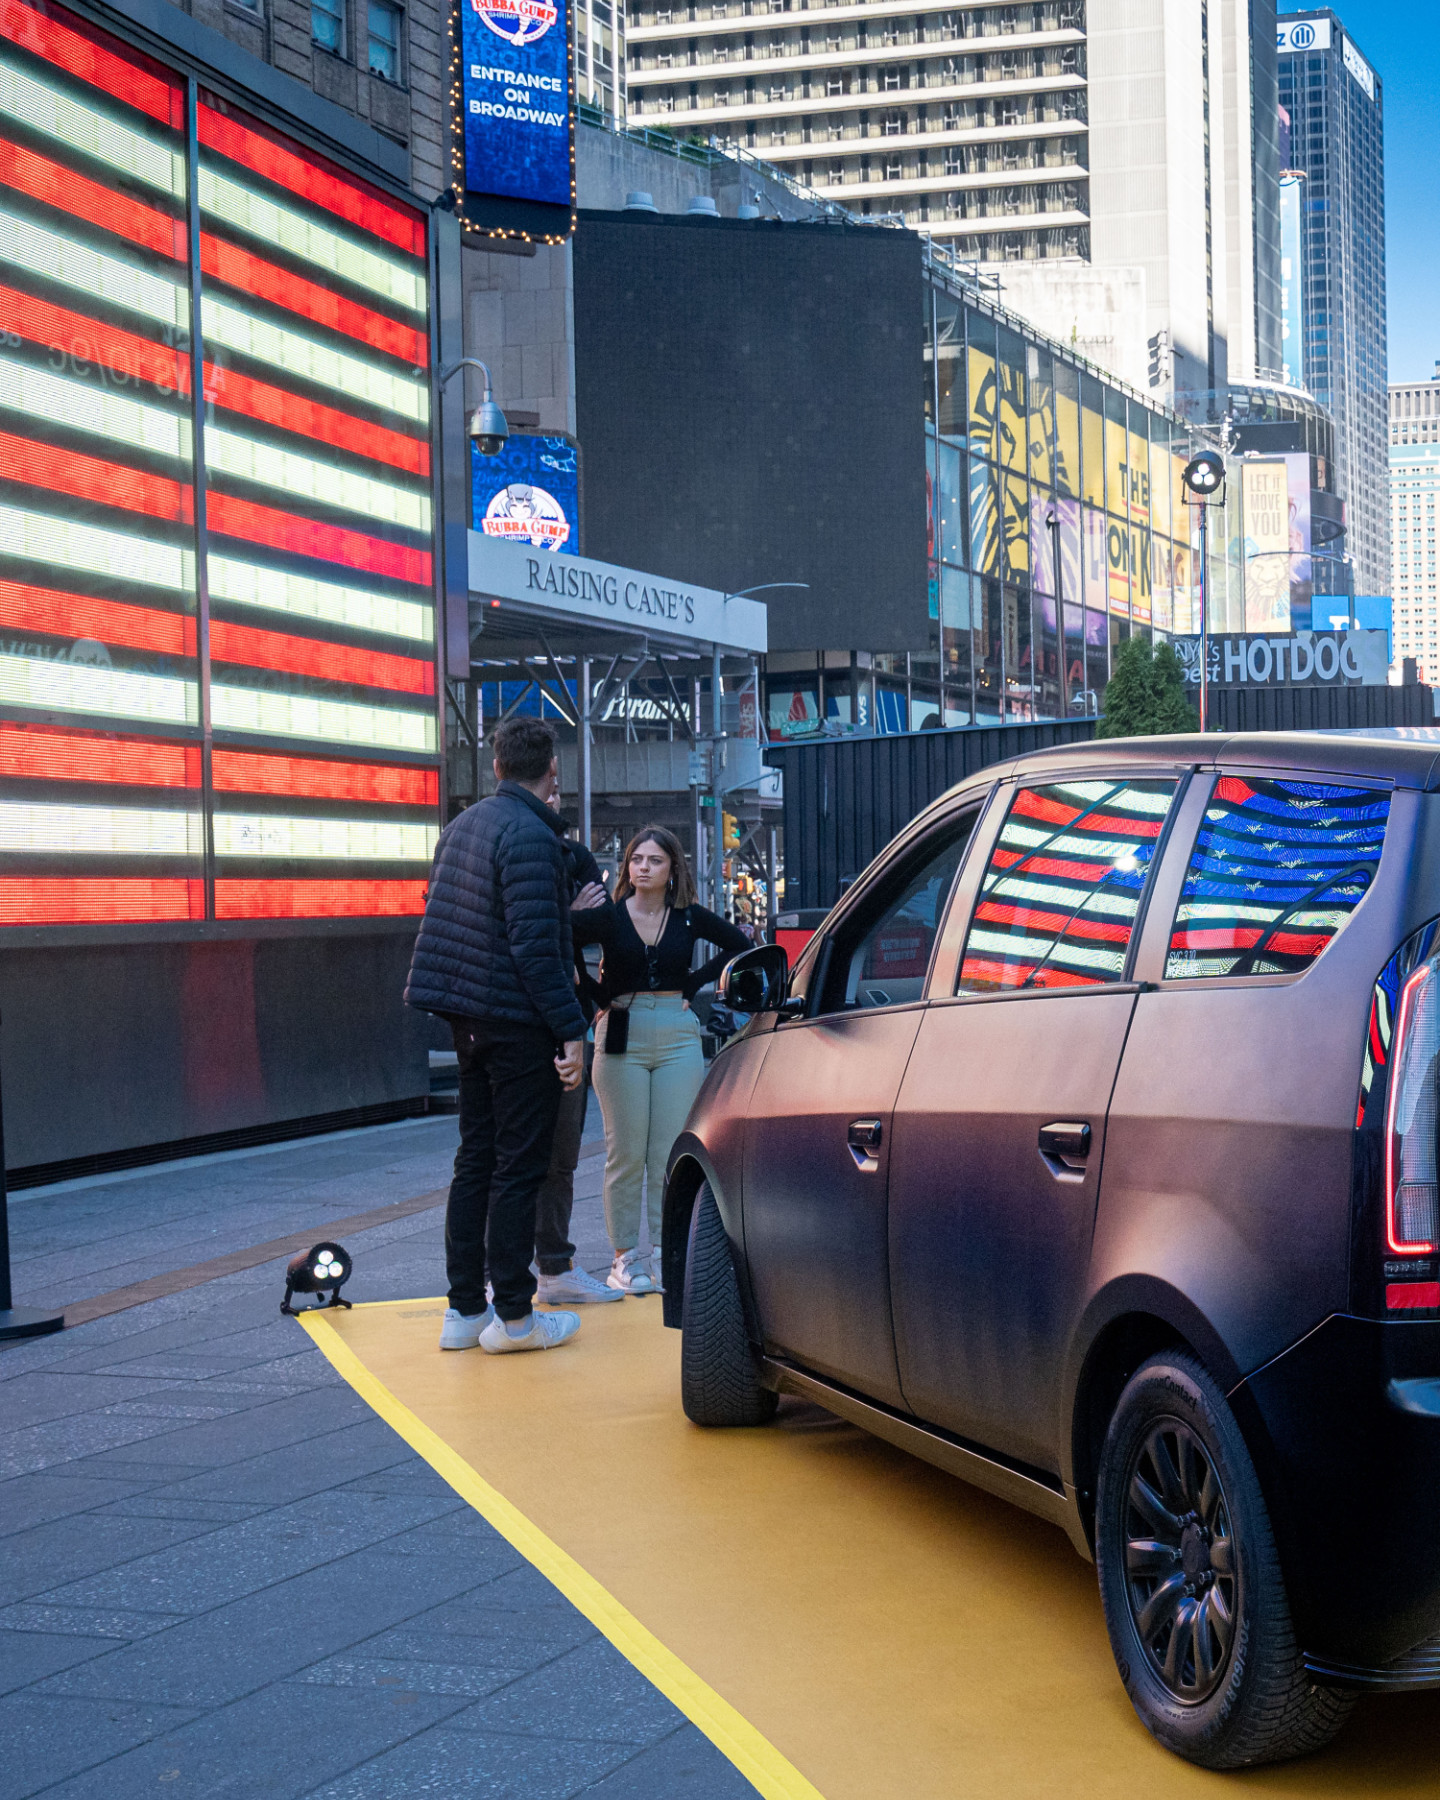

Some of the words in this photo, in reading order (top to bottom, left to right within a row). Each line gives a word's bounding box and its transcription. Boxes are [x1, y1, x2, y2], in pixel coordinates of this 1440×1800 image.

[475, 0, 516, 12] BUBBA
[519, 1, 555, 21] GUMP
[488, 11, 518, 20] SHRIMP
[470, 64, 562, 92] ENTRANCE
[504, 88, 530, 104] ON
[469, 100, 565, 127] BROADWAY
[1118, 462, 1149, 507] THE
[1250, 473, 1268, 492] LET
[1250, 493, 1281, 511] MOVE
[486, 521, 528, 534] BUBBA
[531, 521, 567, 537] GUMP
[1251, 512, 1281, 536] YOU
[526, 558, 618, 606] RAISING
[625, 582, 695, 623] CANE'S
